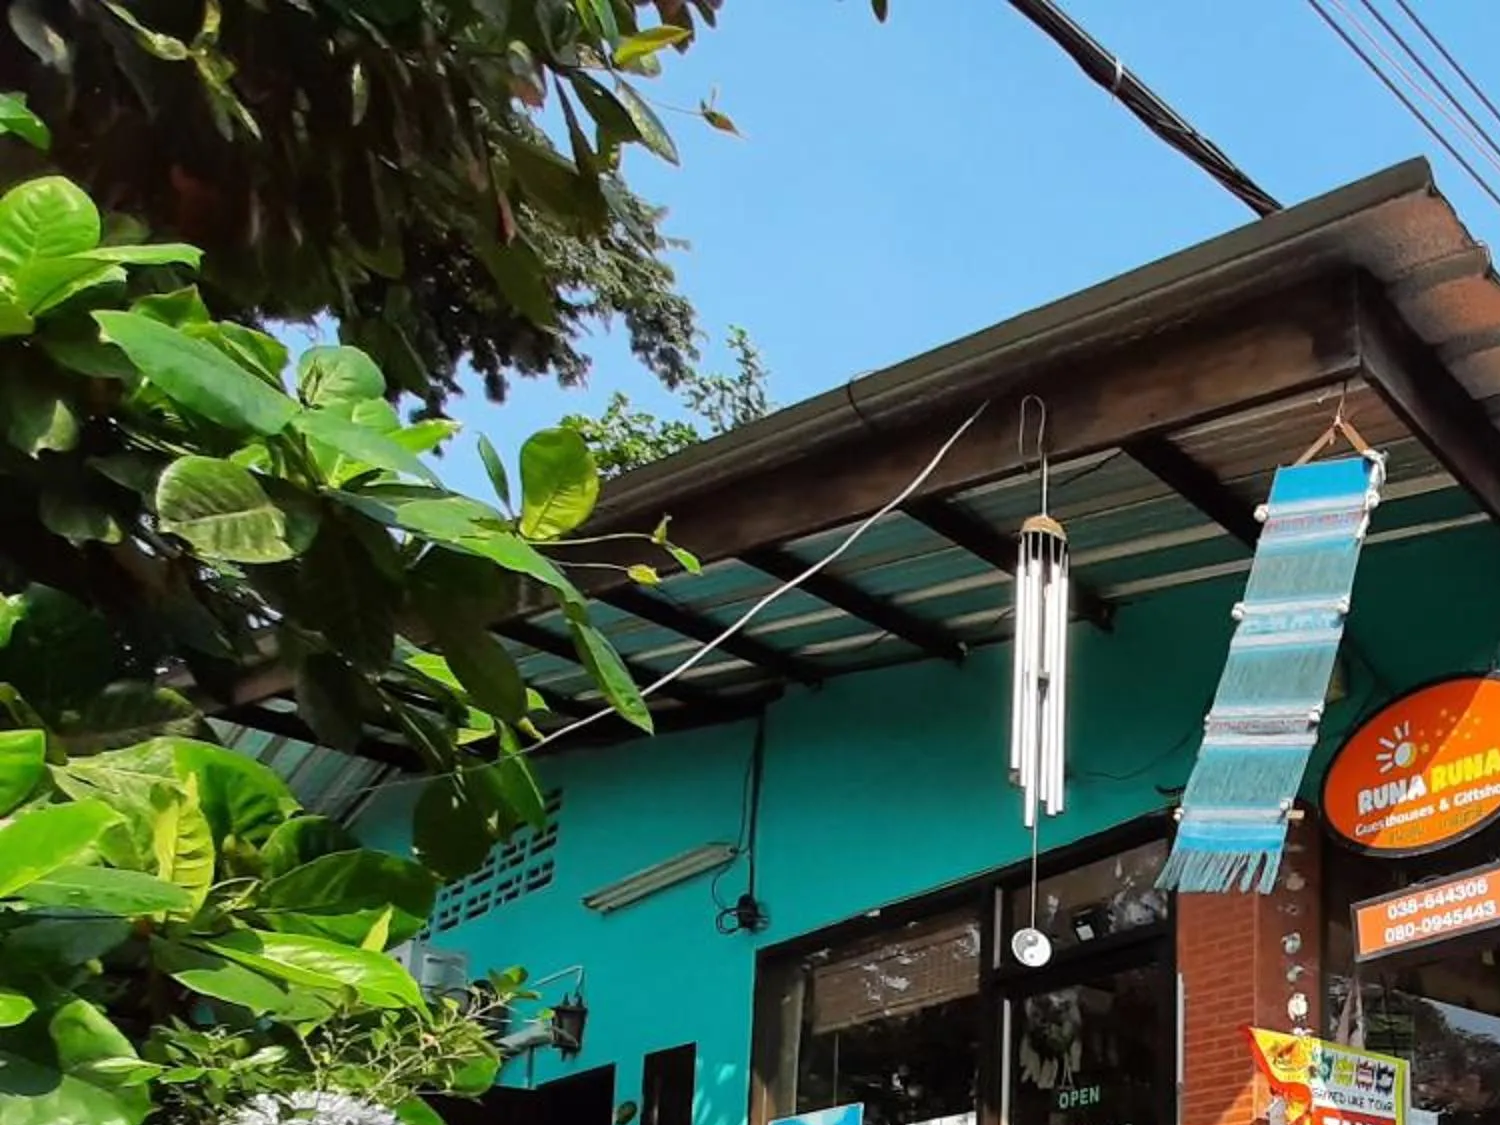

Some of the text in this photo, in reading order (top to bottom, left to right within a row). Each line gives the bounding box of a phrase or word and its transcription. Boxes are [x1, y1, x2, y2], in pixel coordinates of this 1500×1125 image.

[1357, 774, 1427, 815] RUNA
[1355, 804, 1436, 836] Guesthouses
[1439, 796, 1450, 812] &
[1387, 878, 1488, 920] 038-644306
[1384, 902, 1497, 944] 080-0945443
[1059, 1086, 1100, 1109] OPEN
